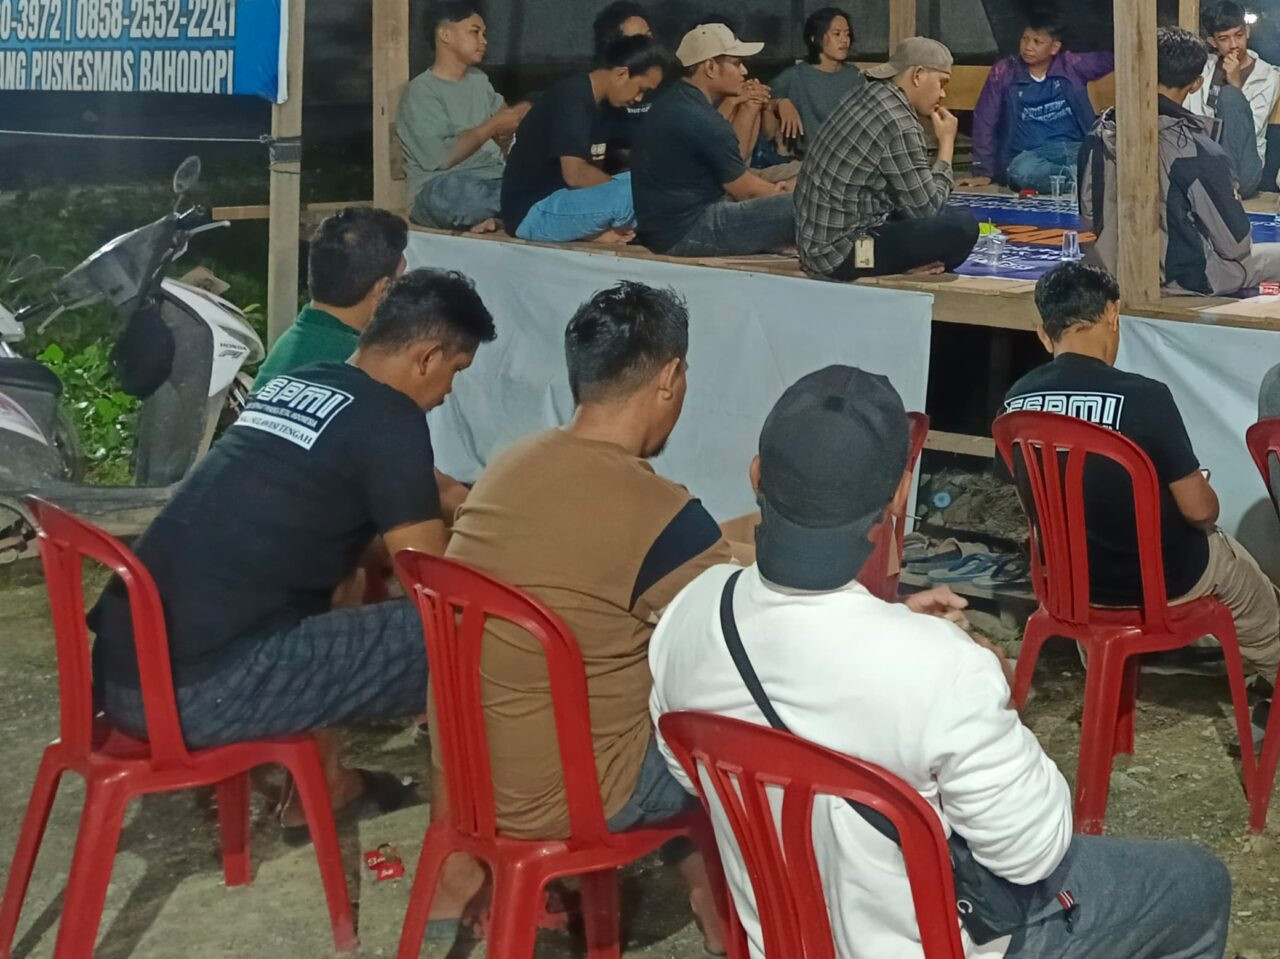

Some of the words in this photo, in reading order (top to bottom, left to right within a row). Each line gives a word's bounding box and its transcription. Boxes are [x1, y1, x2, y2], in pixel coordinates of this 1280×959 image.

[31, 50, 135, 91] PUSKESMAS
[140, 49, 234, 95] BAHODOPI
[255, 378, 345, 419] SPMI
[279, 423, 313, 445] TENGAH
